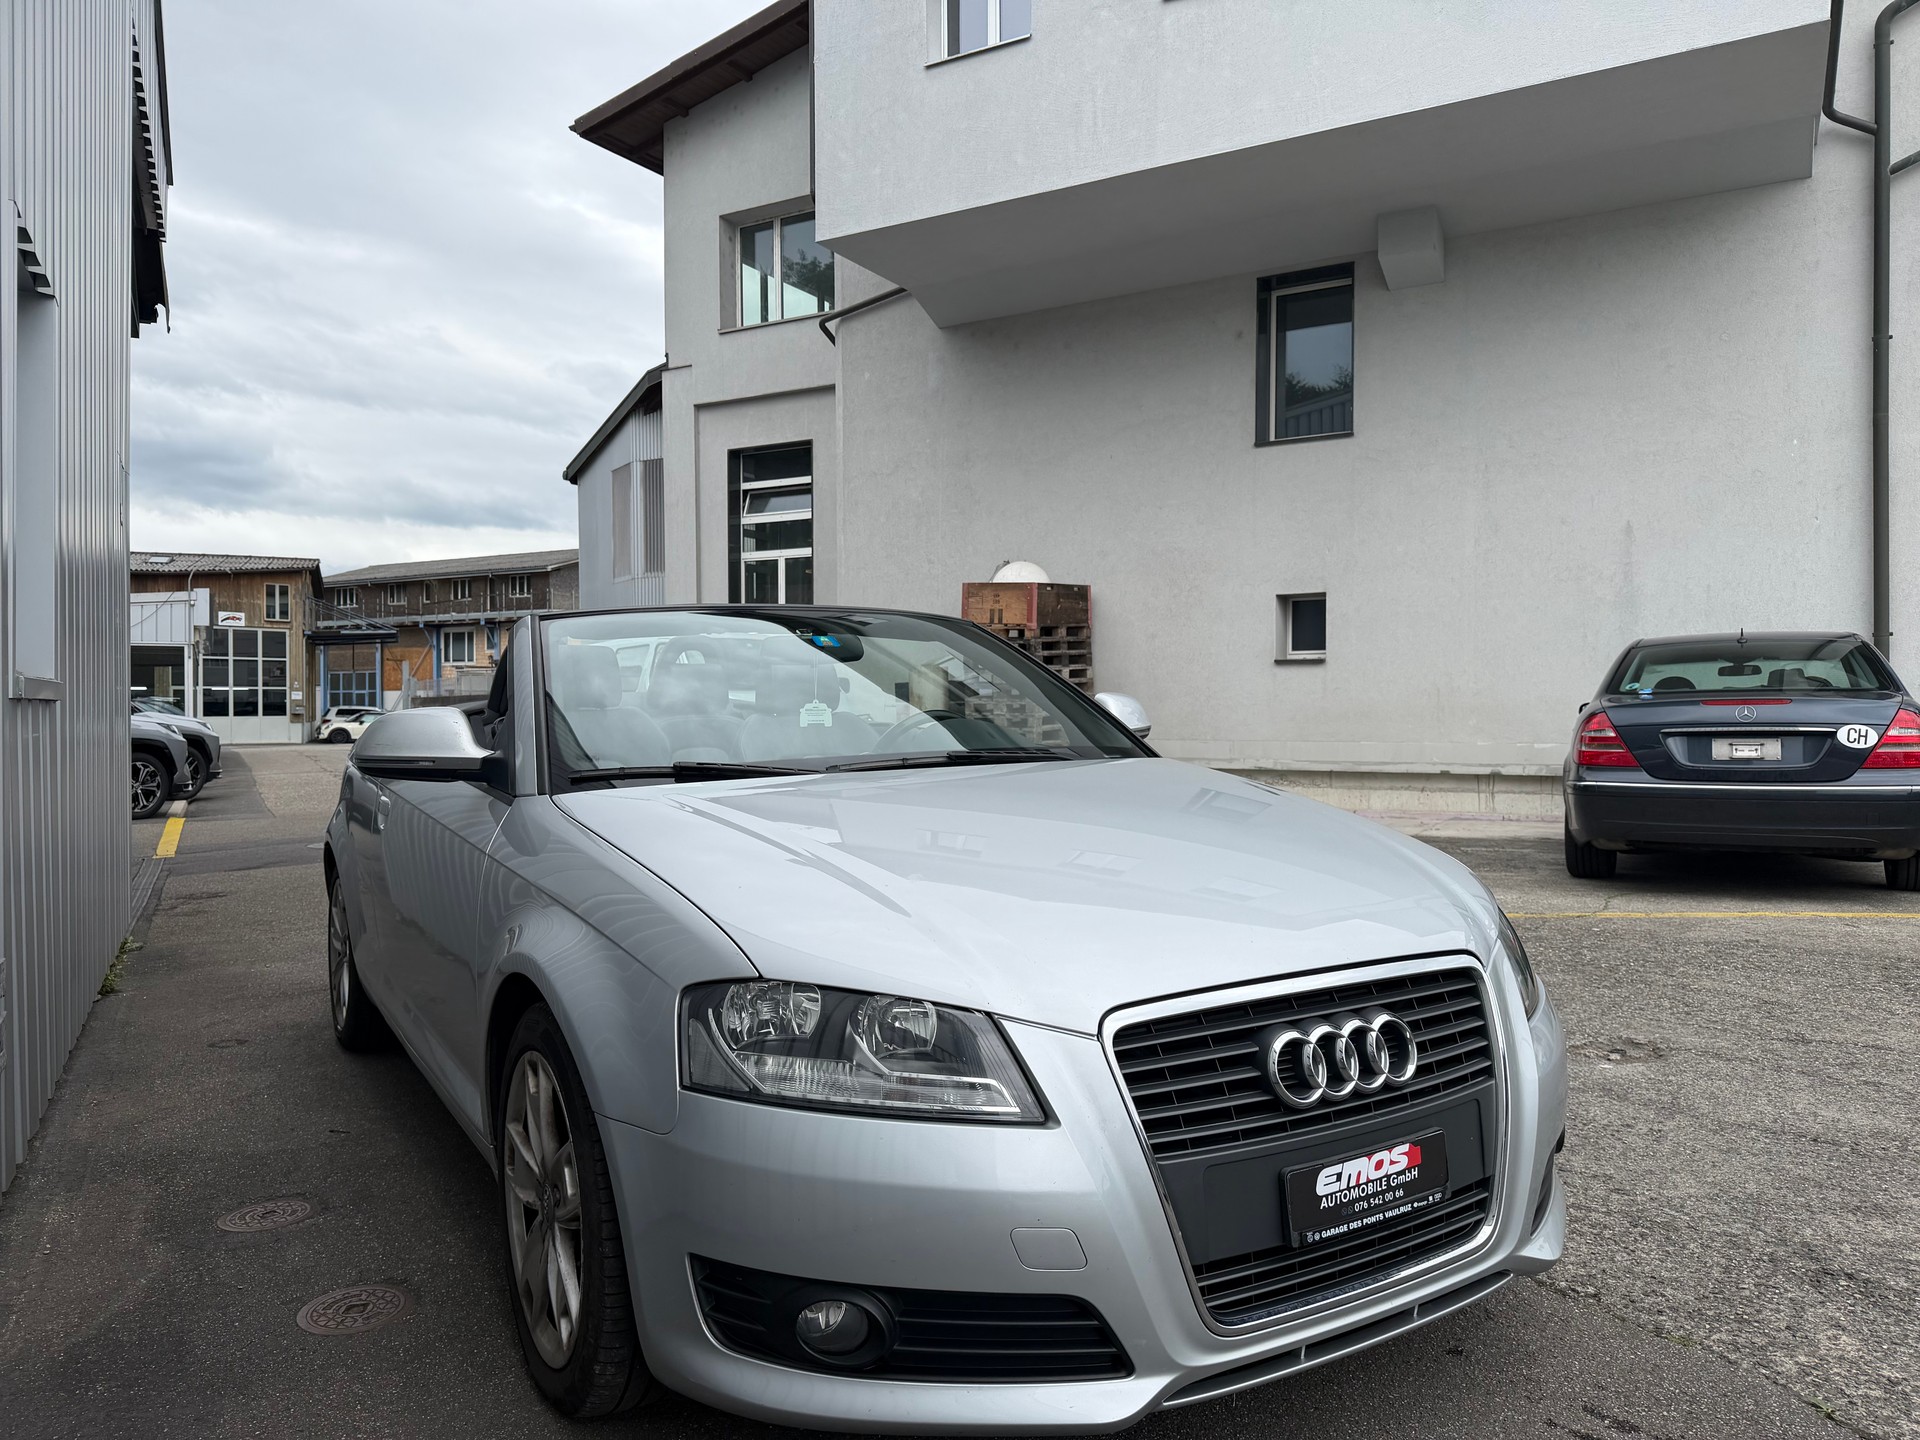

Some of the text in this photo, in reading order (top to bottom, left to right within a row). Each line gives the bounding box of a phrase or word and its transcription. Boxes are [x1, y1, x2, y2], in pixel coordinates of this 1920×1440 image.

[1846, 727, 1869, 746] CH
[1320, 1167, 1419, 1210] AUTOMOBILE GmbH
[1354, 1189, 1405, 1212] 076 542 00 66
[1321, 1223, 1349, 1238] GARAGE
[1349, 1219, 1362, 1229] DES
[1363, 1213, 1384, 1225] PONTS
[1384, 1203, 1412, 1219] VAULRUZ
